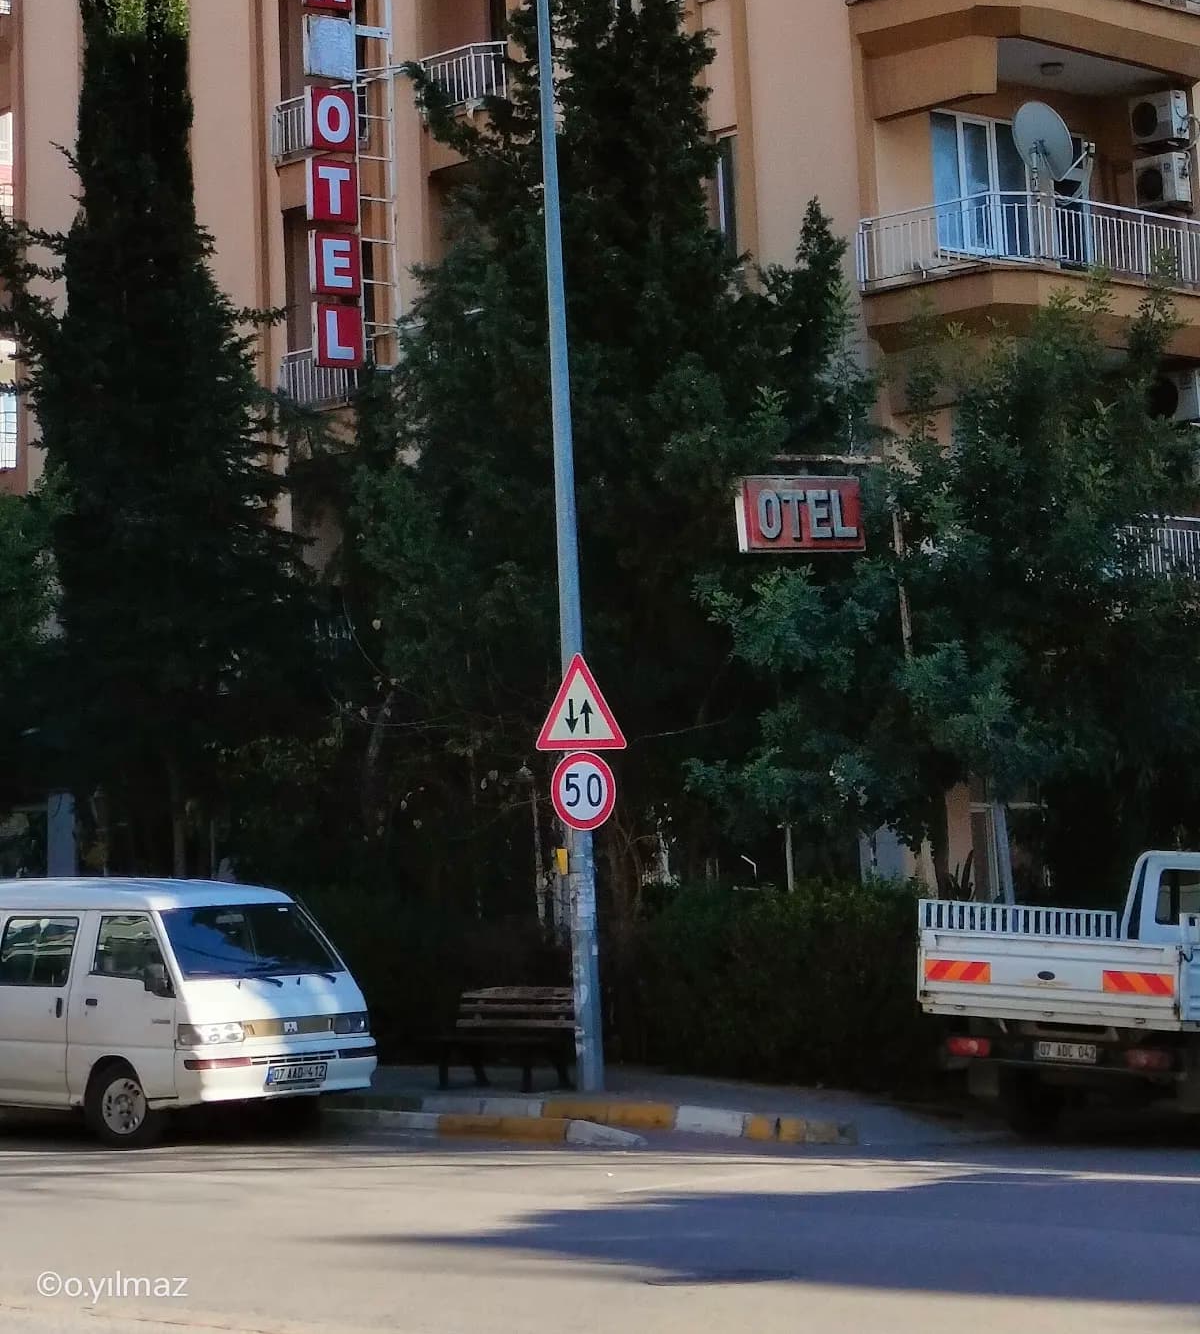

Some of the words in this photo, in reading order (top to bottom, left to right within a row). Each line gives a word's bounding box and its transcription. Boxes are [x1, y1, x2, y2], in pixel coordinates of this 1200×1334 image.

[316, 95, 355, 359] OTEL
[757, 489, 858, 539] OTEL
[565, 772, 603, 808] 50
